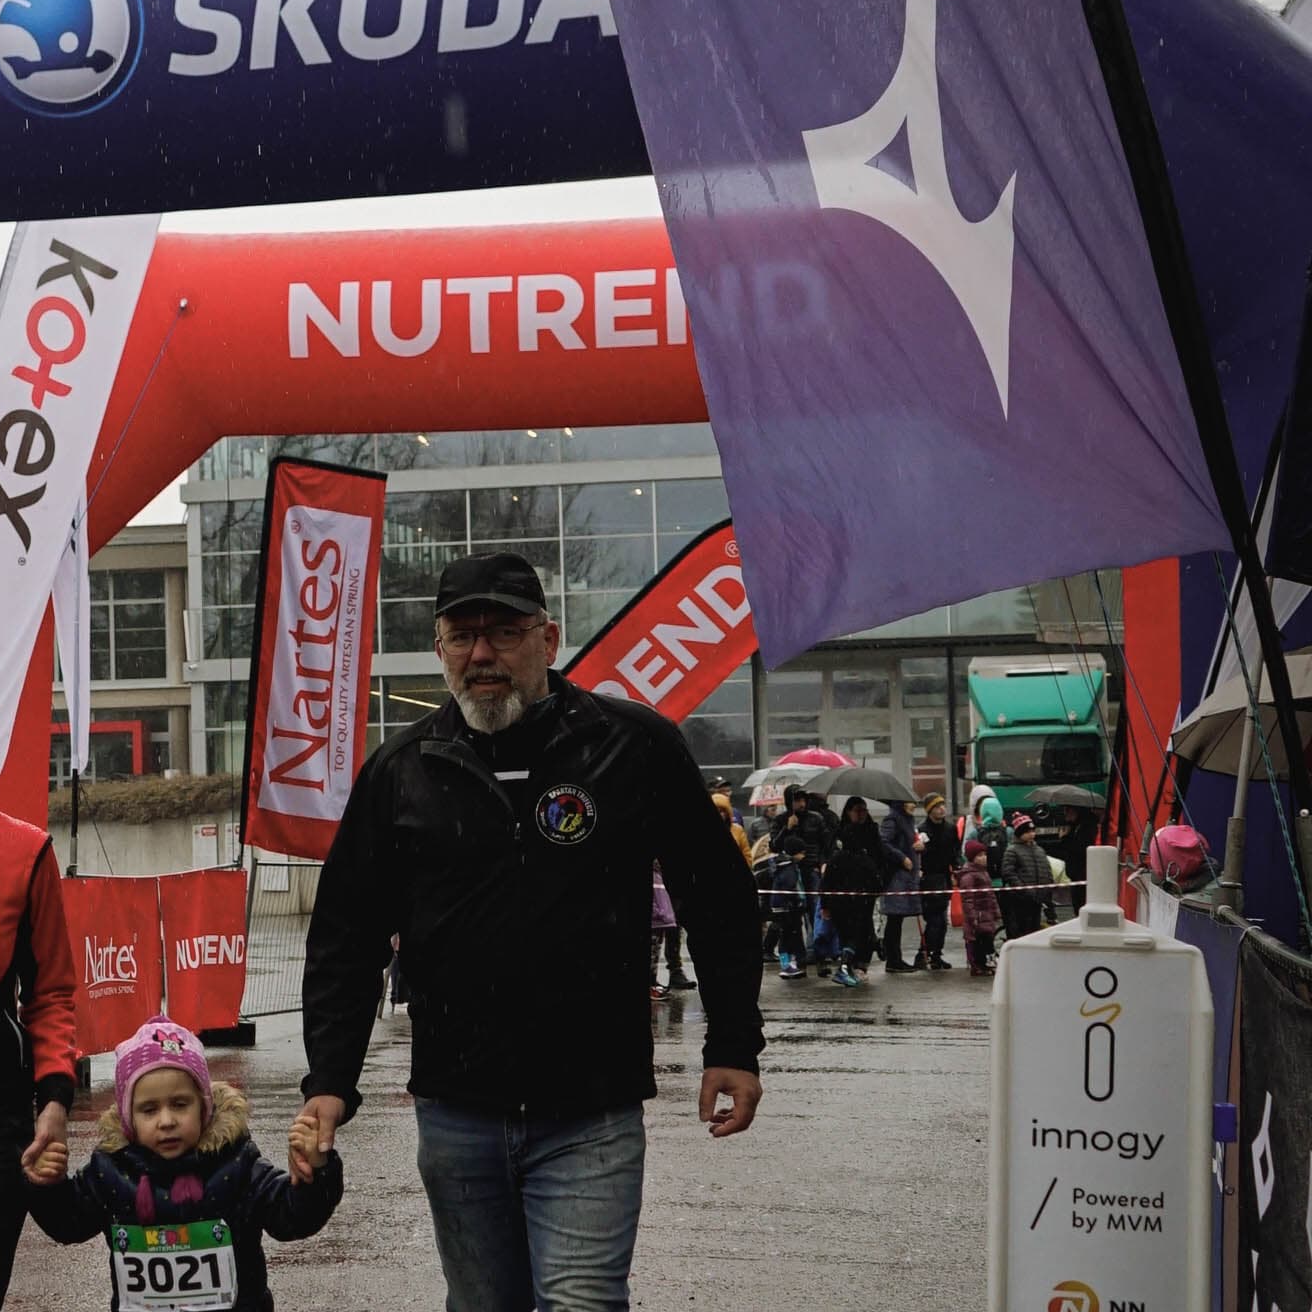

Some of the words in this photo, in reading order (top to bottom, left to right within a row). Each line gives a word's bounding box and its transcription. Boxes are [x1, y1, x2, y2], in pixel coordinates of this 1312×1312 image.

[346, 567, 361, 616] SPRING
[341, 618, 356, 682] ARTESIAN
[337, 685, 350, 743] QUALITY
[334, 745, 345, 772] TOP
[1031, 1118, 1165, 1160] innogy
[1072, 1187, 1165, 1209] Powered
[1072, 1211, 1097, 1233] by
[1107, 1213, 1162, 1232] MVM
[123, 1253, 222, 1293] 3021
